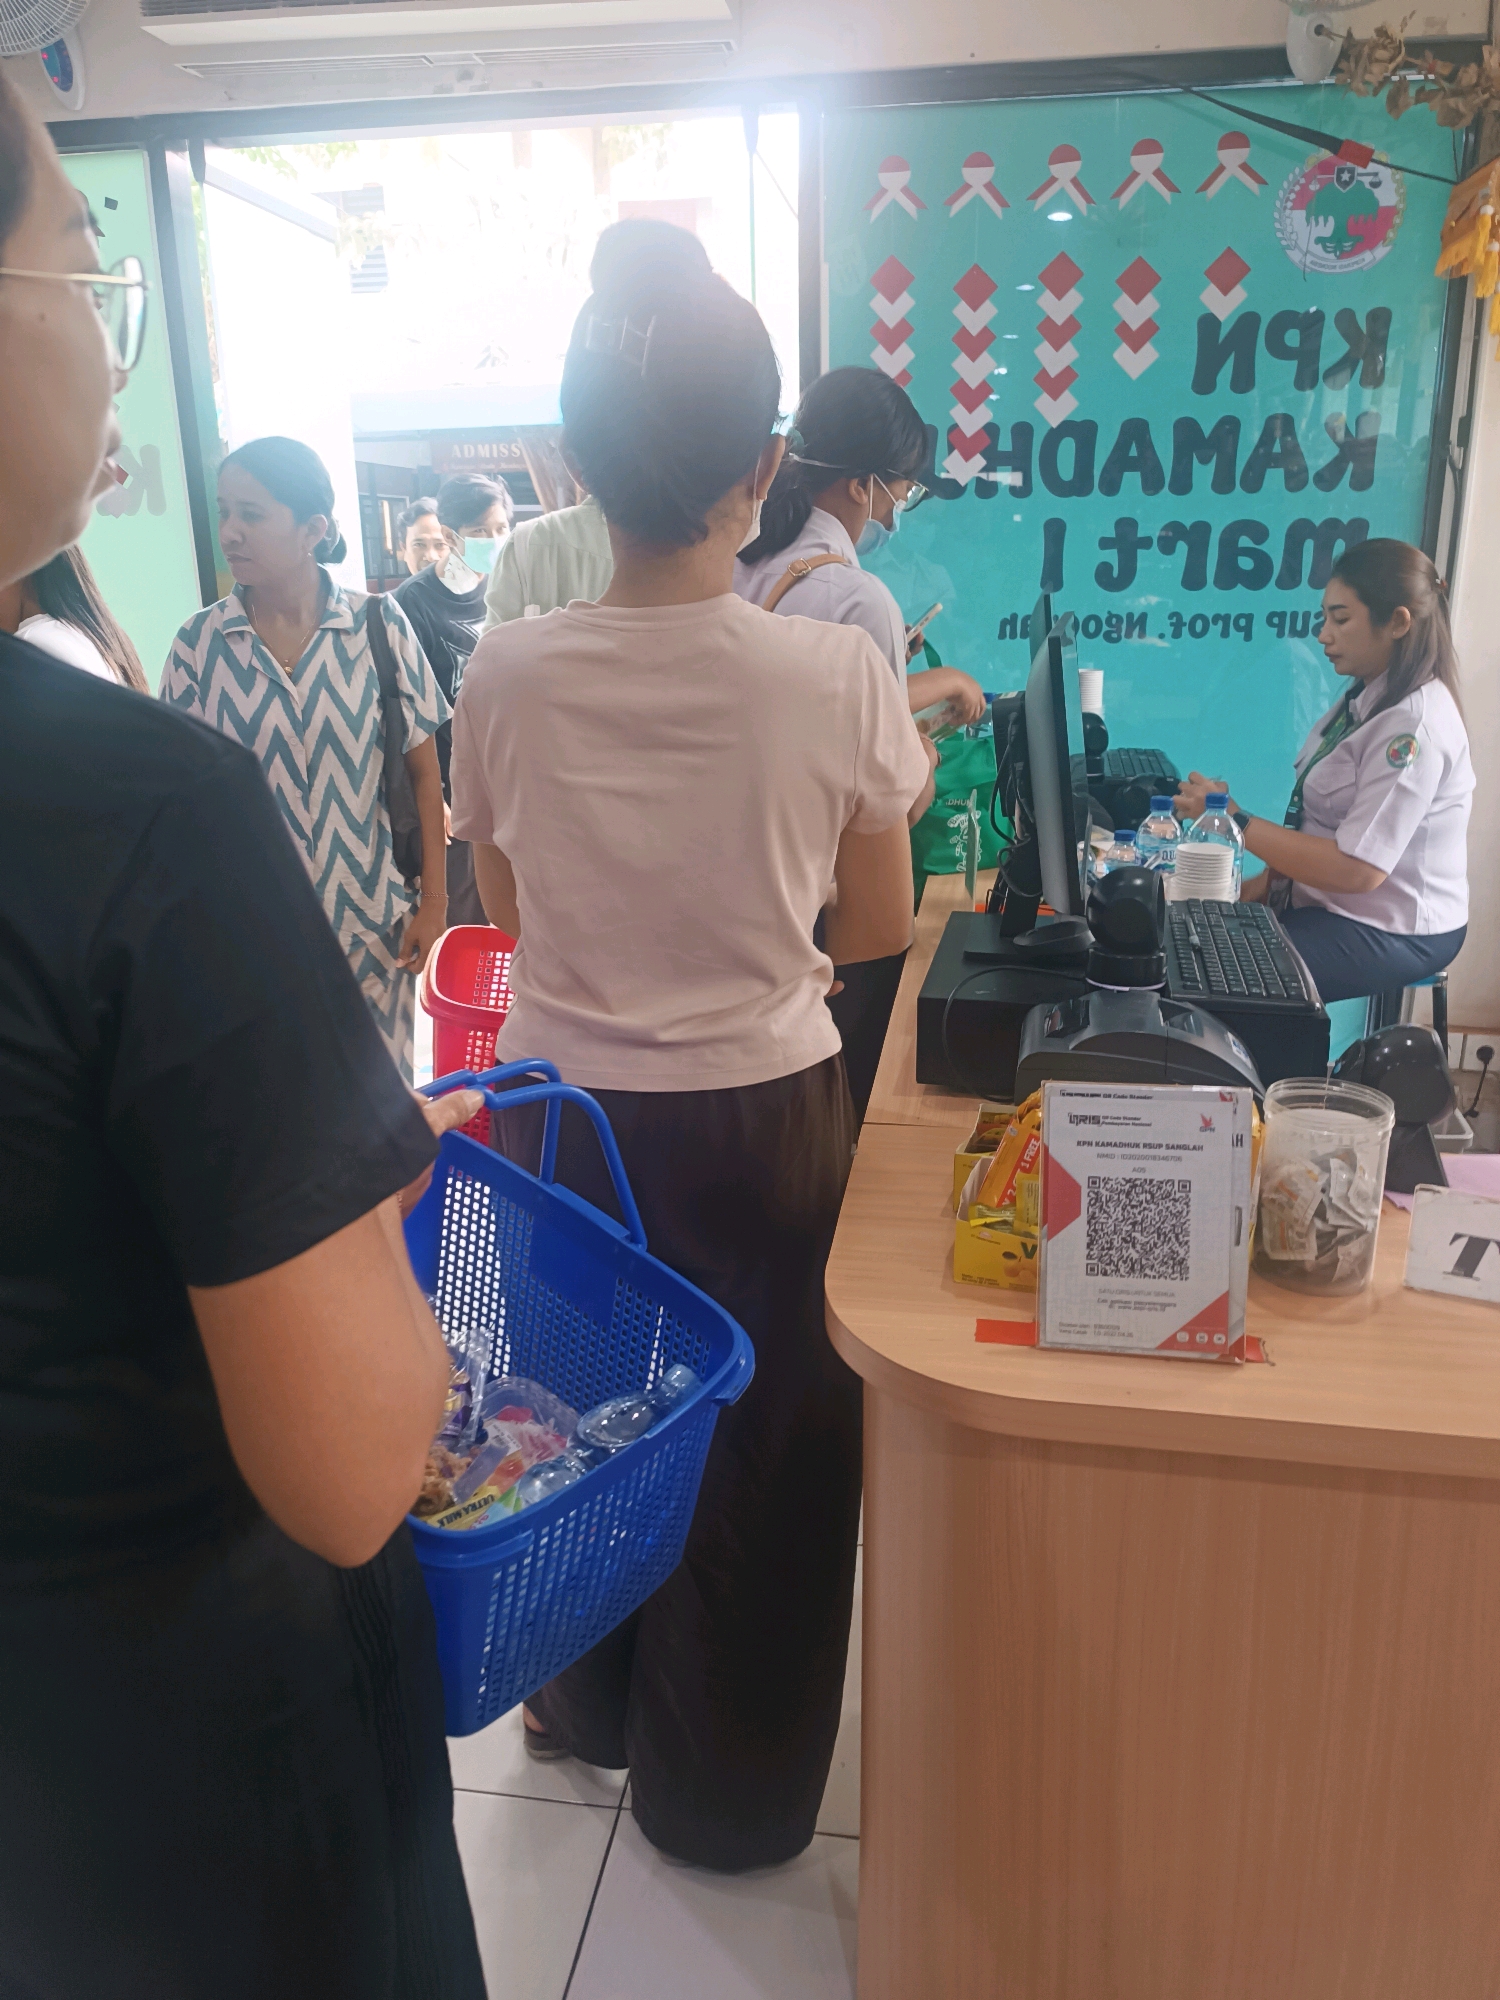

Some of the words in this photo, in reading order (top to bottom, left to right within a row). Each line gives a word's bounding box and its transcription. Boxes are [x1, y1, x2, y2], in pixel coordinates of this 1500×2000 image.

[1076, 1140, 1094, 1148] KPN
[1094, 1141, 1141, 1149] KAMADHUK
[1142, 1142, 1164, 1150] RSUP
[1164, 1143, 1204, 1152] SANGLAH
[462, 1493, 496, 1517] ULTRA
